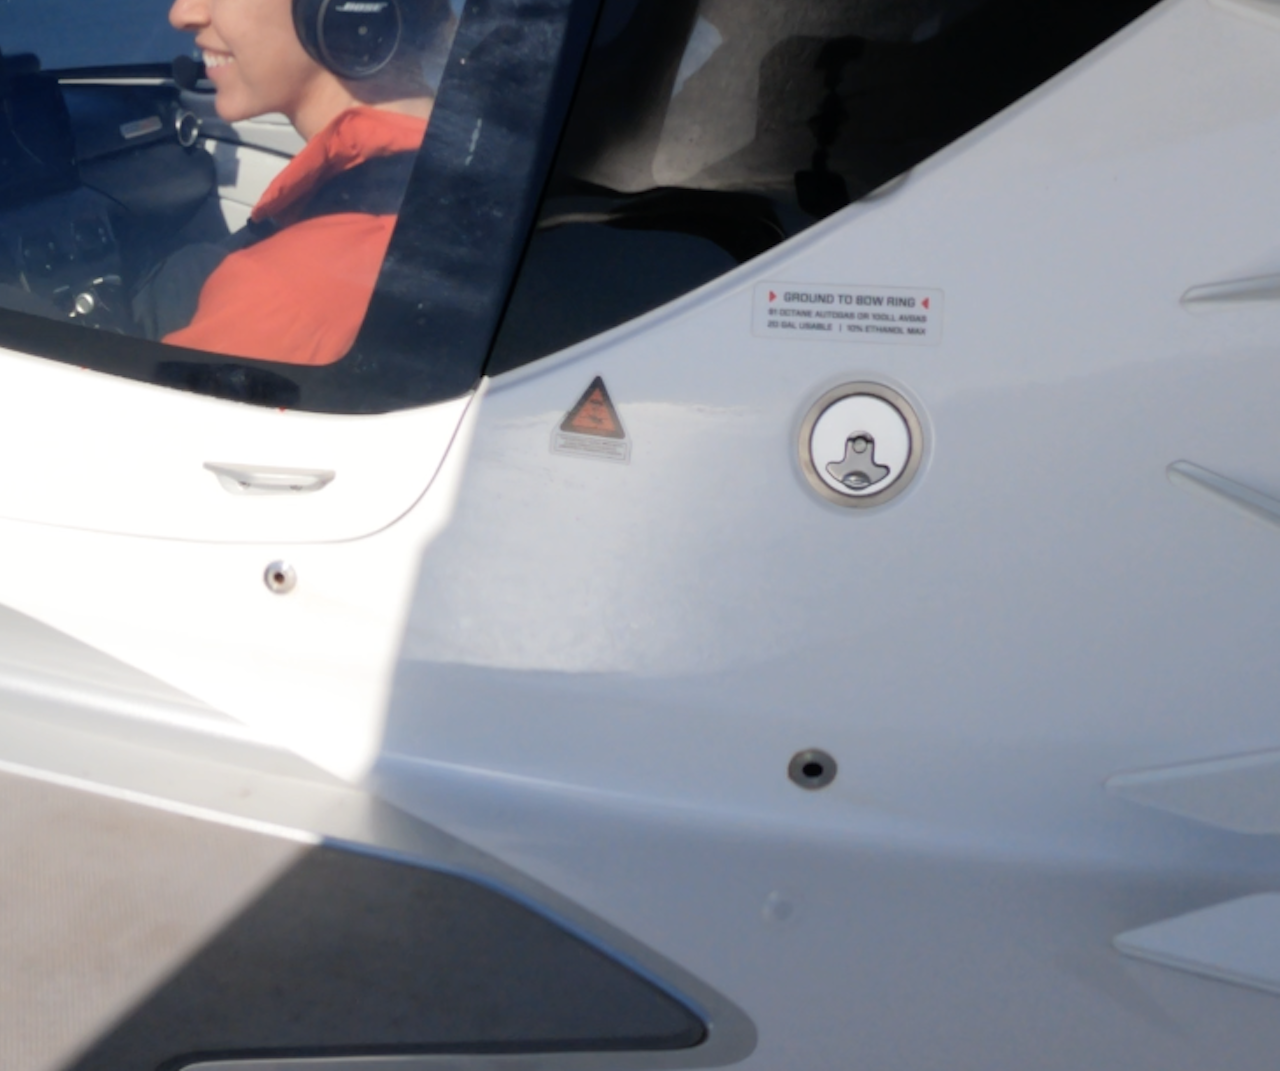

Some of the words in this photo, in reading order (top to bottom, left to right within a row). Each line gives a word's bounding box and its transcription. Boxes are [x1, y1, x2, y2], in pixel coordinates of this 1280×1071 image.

[783, 292, 834, 304] GROUND
[838, 294, 853, 305] TO
[856, 295, 883, 306] BOW
[887, 296, 916, 308] RING
[779, 309, 812, 318] OCTANE
[814, 310, 855, 320] AUTOGAS
[857, 312, 870, 320] OR
[781, 321, 797, 329] GAL
[799, 322, 832, 331] USABLE
[865, 325, 904, 334] ETHANOL
[907, 327, 926, 336] MAX
